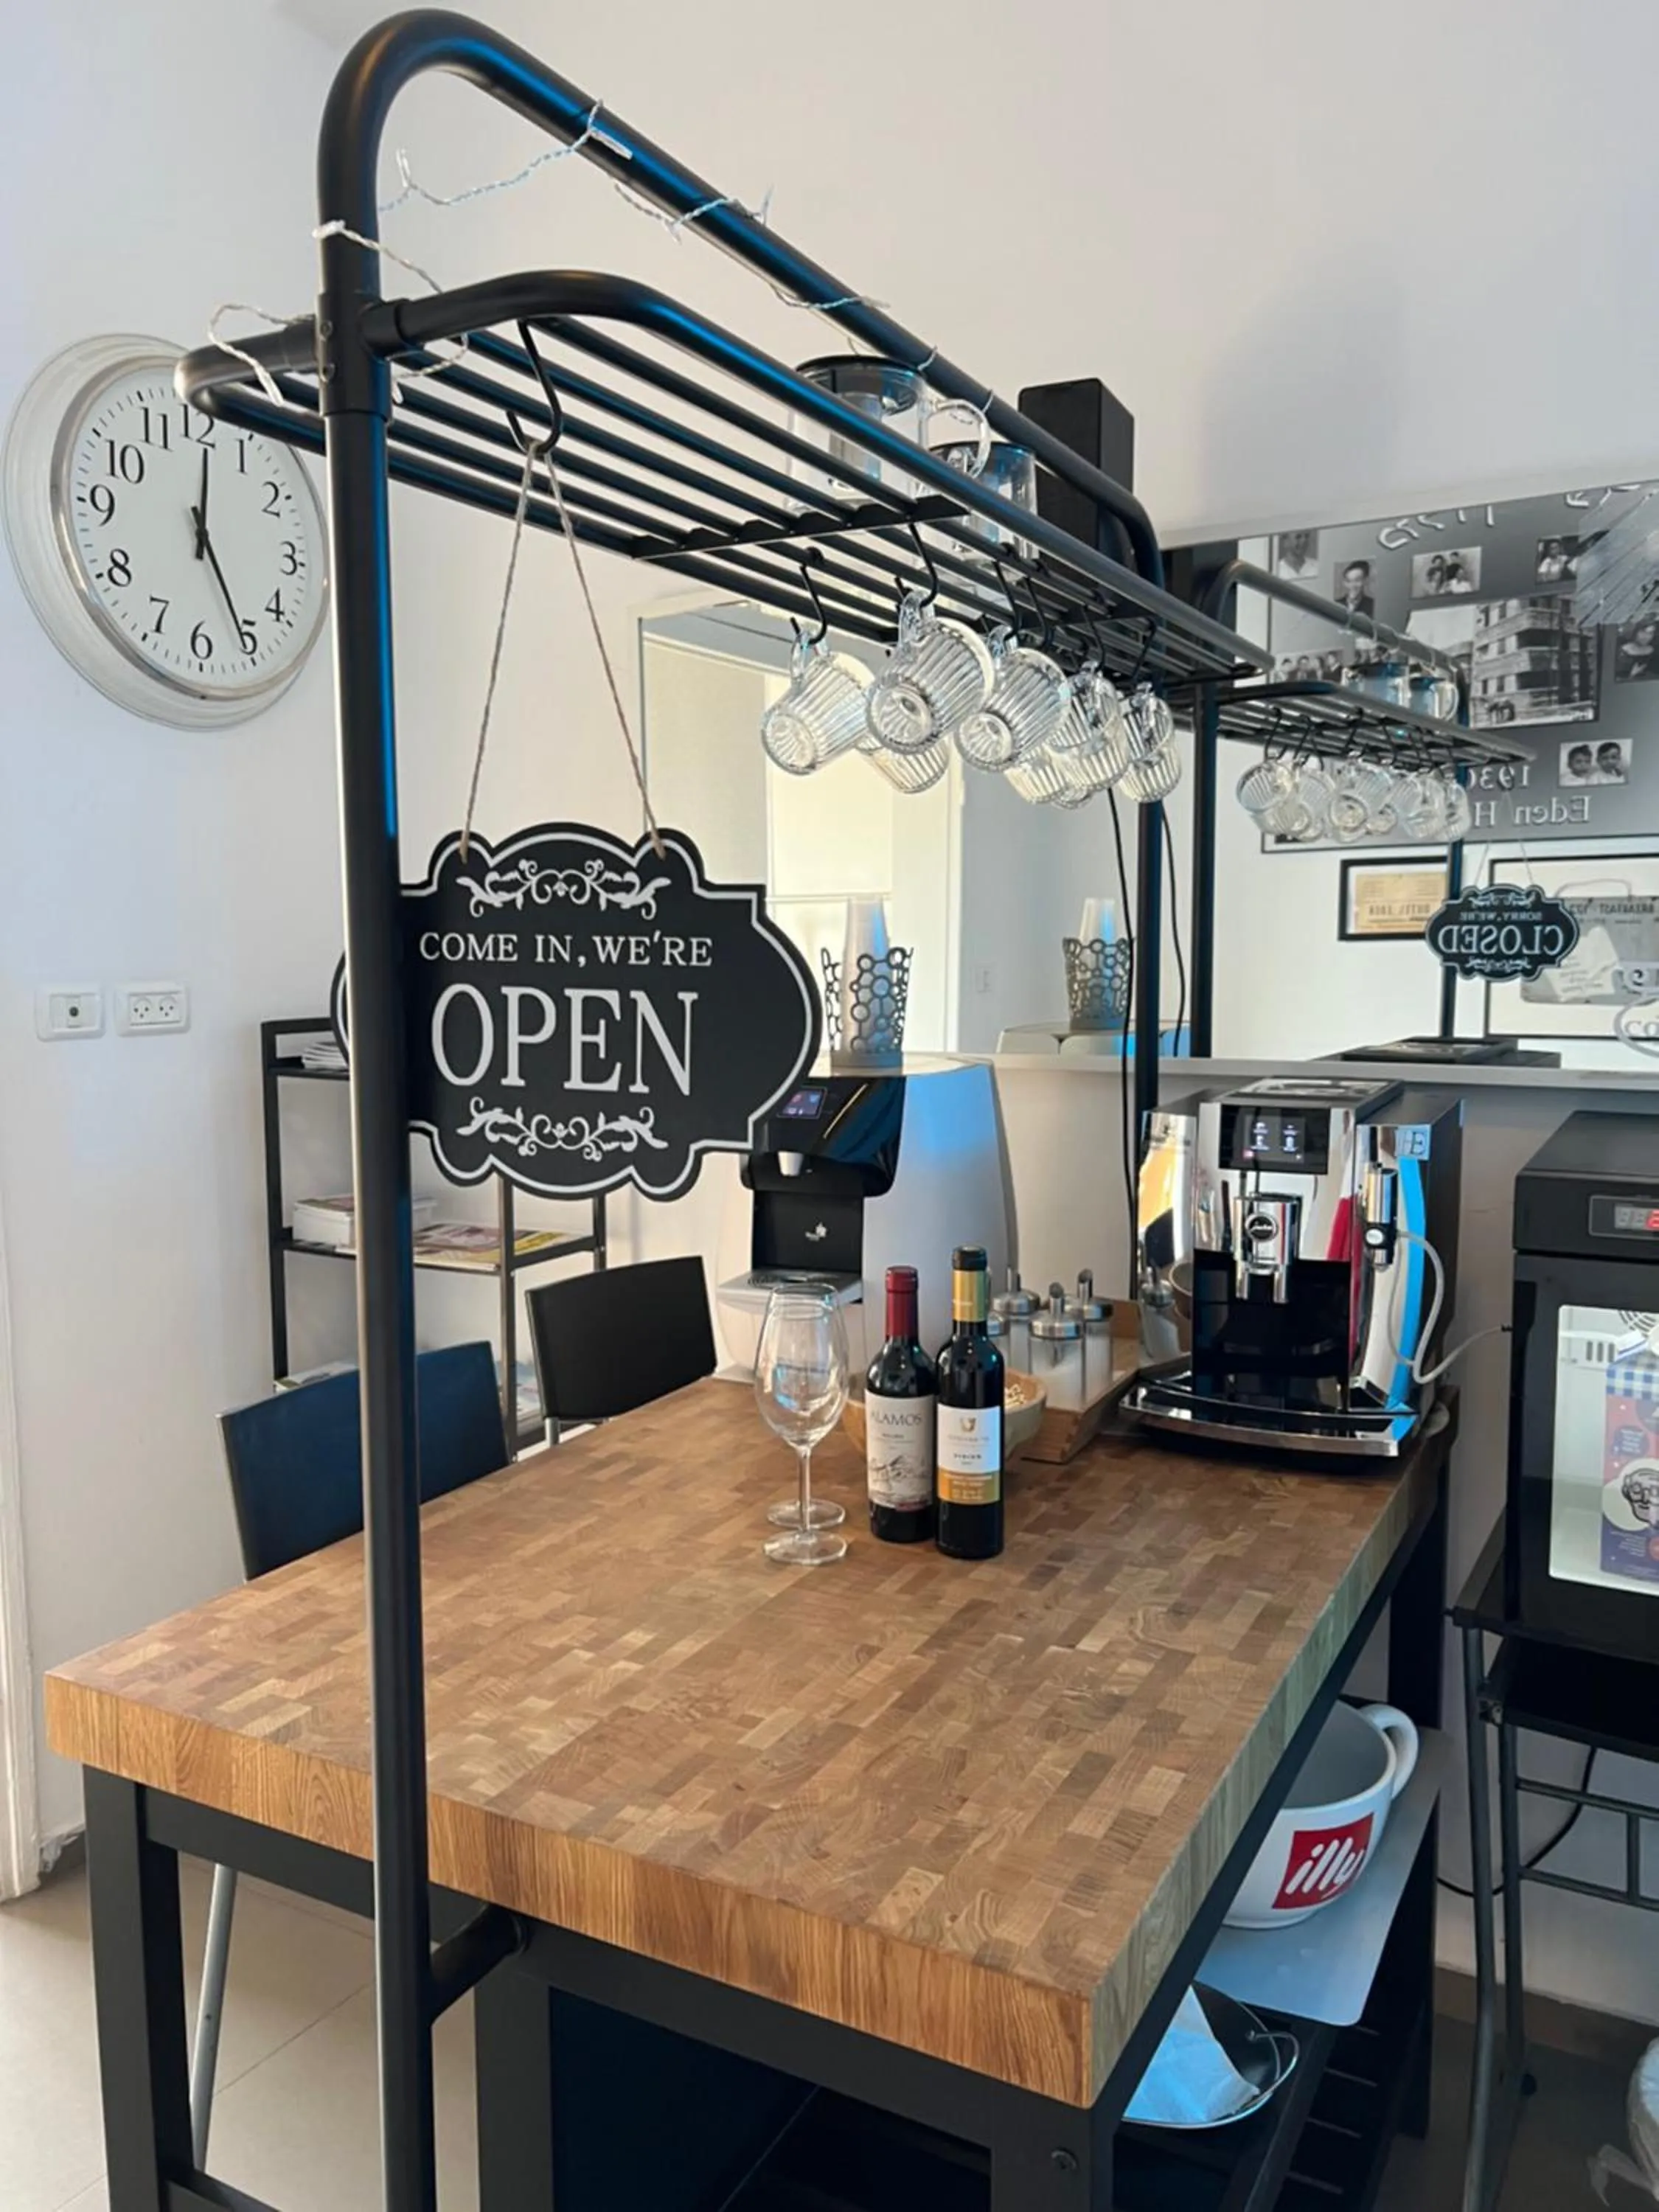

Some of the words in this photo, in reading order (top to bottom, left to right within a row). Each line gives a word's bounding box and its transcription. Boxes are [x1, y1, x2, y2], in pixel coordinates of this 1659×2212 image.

[140, 406, 173, 451] 11
[181, 403, 216, 448] 12
[105, 439, 145, 484] 10
[237, 438, 247, 474] 1
[89, 484, 116, 526] 9
[262, 481, 281, 518] 2
[107, 549, 132, 587] 8
[280, 541, 296, 575] 3
[149, 595, 170, 634] 7
[265, 588, 285, 622] 4
[190, 621, 213, 660] 6
[240, 618, 259, 655] 5
[420, 932, 518, 961] COME
[535, 934, 587, 967] IN,
[593, 930, 713, 967] WE'RE
[431, 983, 698, 1096] OPEN
[1285, 1836, 1365, 1899] illy
